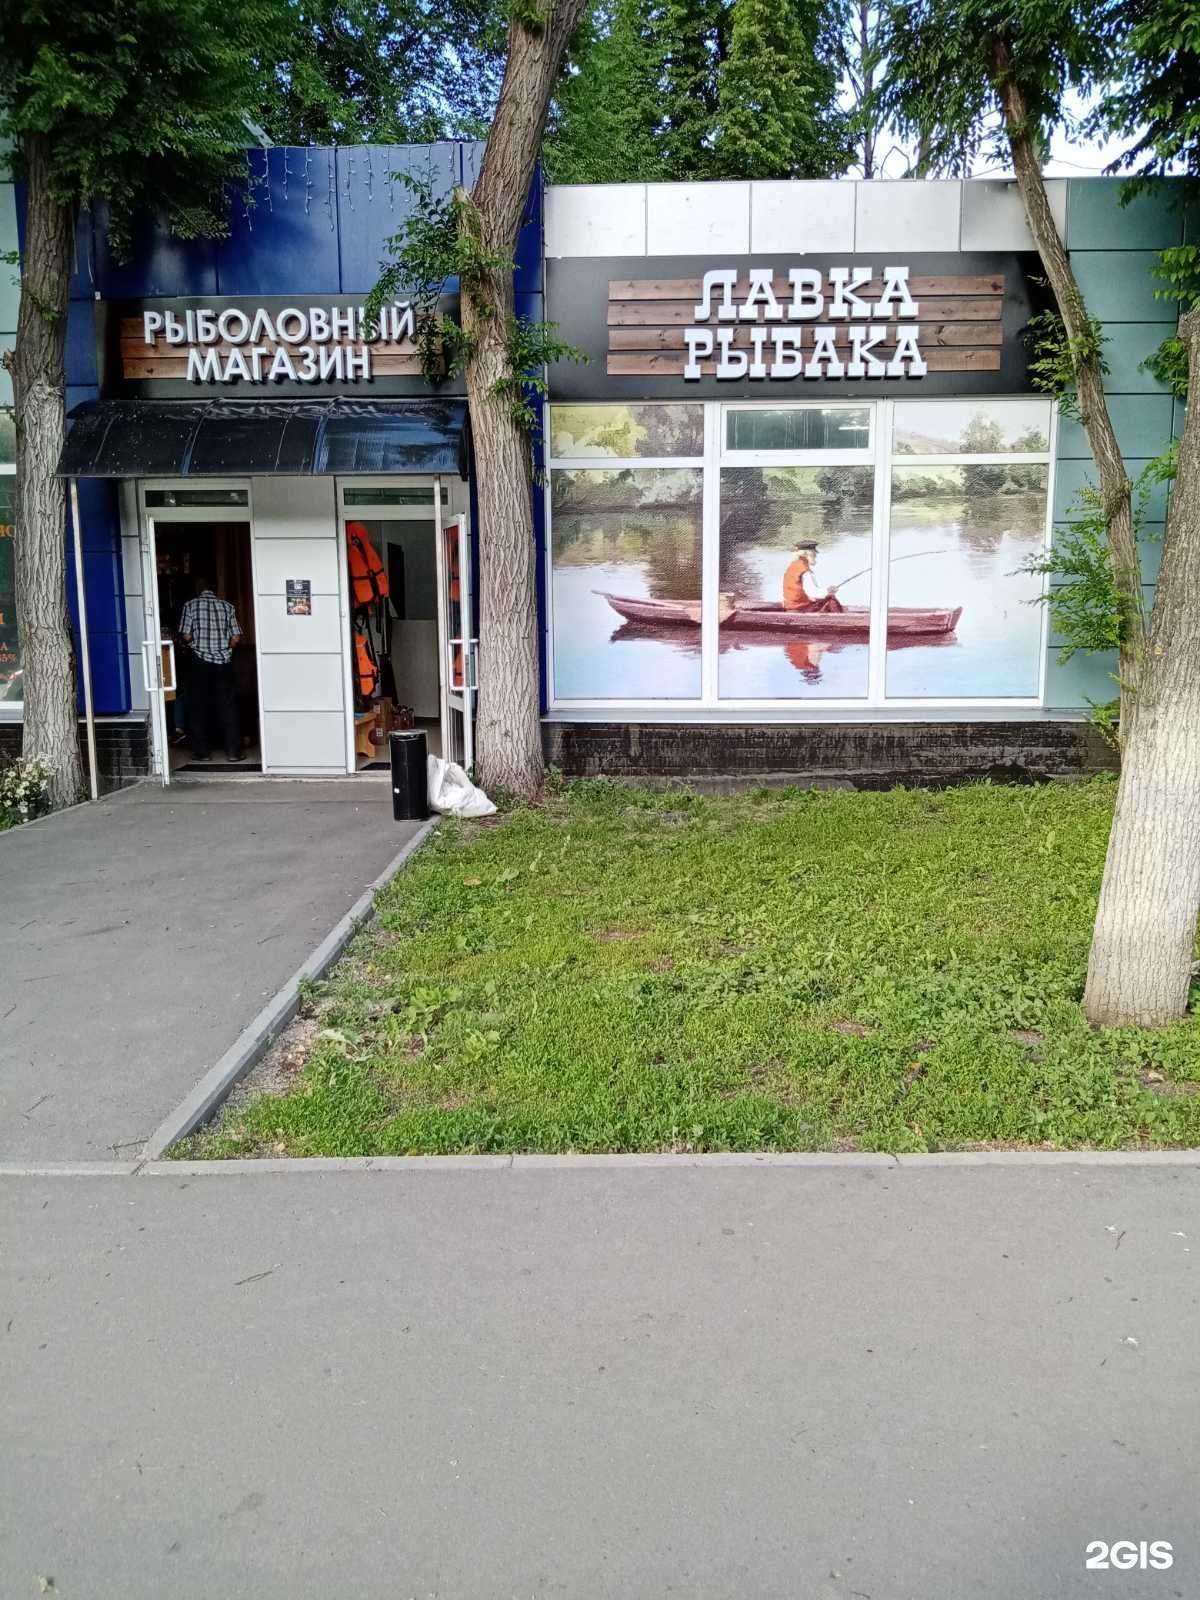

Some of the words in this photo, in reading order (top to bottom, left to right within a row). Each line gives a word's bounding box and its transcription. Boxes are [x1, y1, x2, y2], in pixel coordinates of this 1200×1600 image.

[694, 266, 919, 321] ЛАВКА
[143, 300, 414, 344] РЫБОЛОВНЫЙ
[186, 346, 371, 381] МАГАЗИН
[683, 325, 927, 380] РЫБАКА
